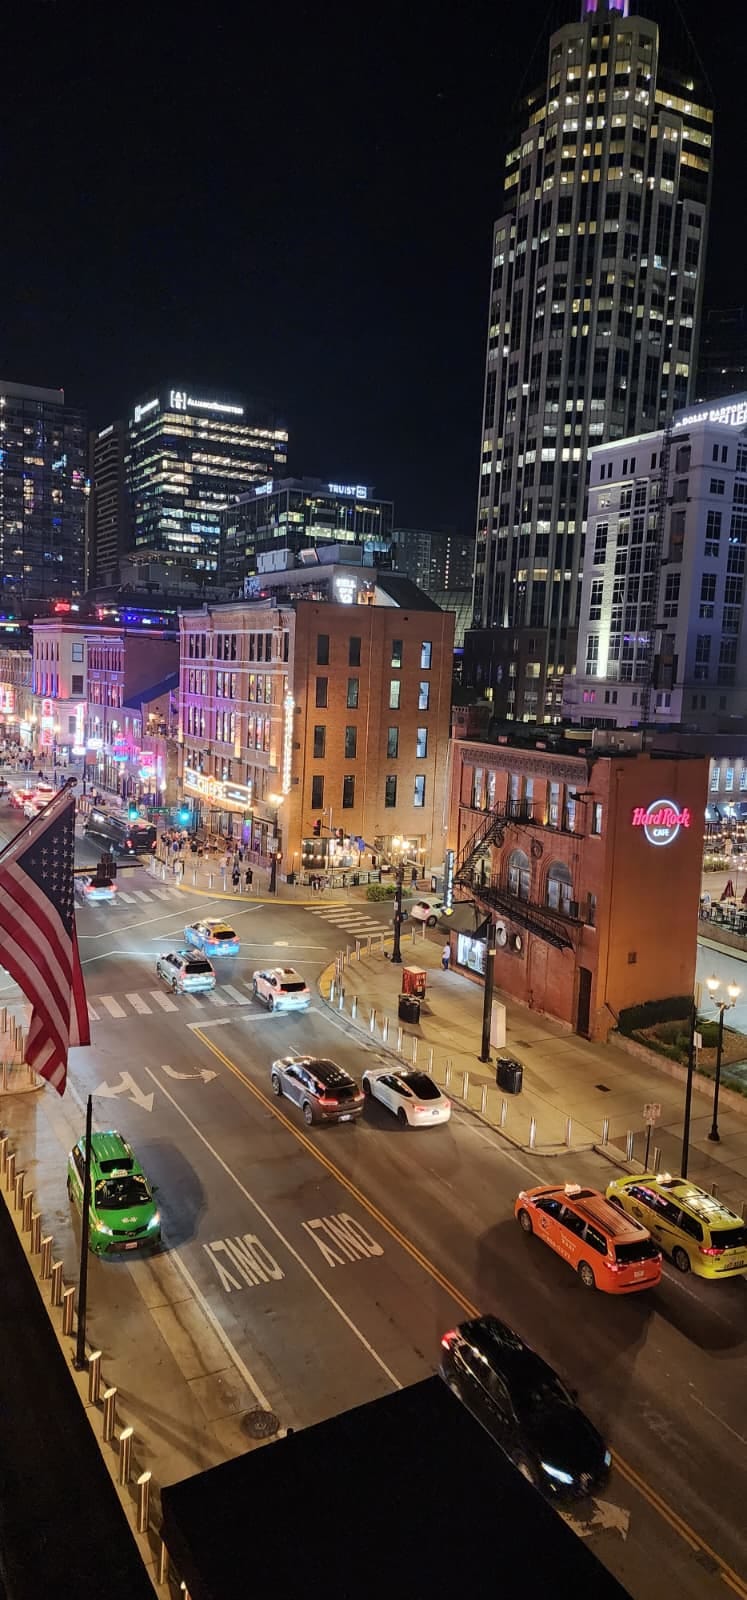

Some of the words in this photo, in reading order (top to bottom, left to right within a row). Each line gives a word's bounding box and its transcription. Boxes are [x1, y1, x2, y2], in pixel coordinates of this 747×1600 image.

[682, 411, 709, 426] DOLLY
[328, 484, 356, 495] TRUIST
[632, 807, 663, 826] Hard
[661, 807, 690, 828] Rock
[653, 828, 670, 837] CAFE
[301, 1212, 384, 1267] ONLY
[202, 1233, 285, 1292] ONLY
